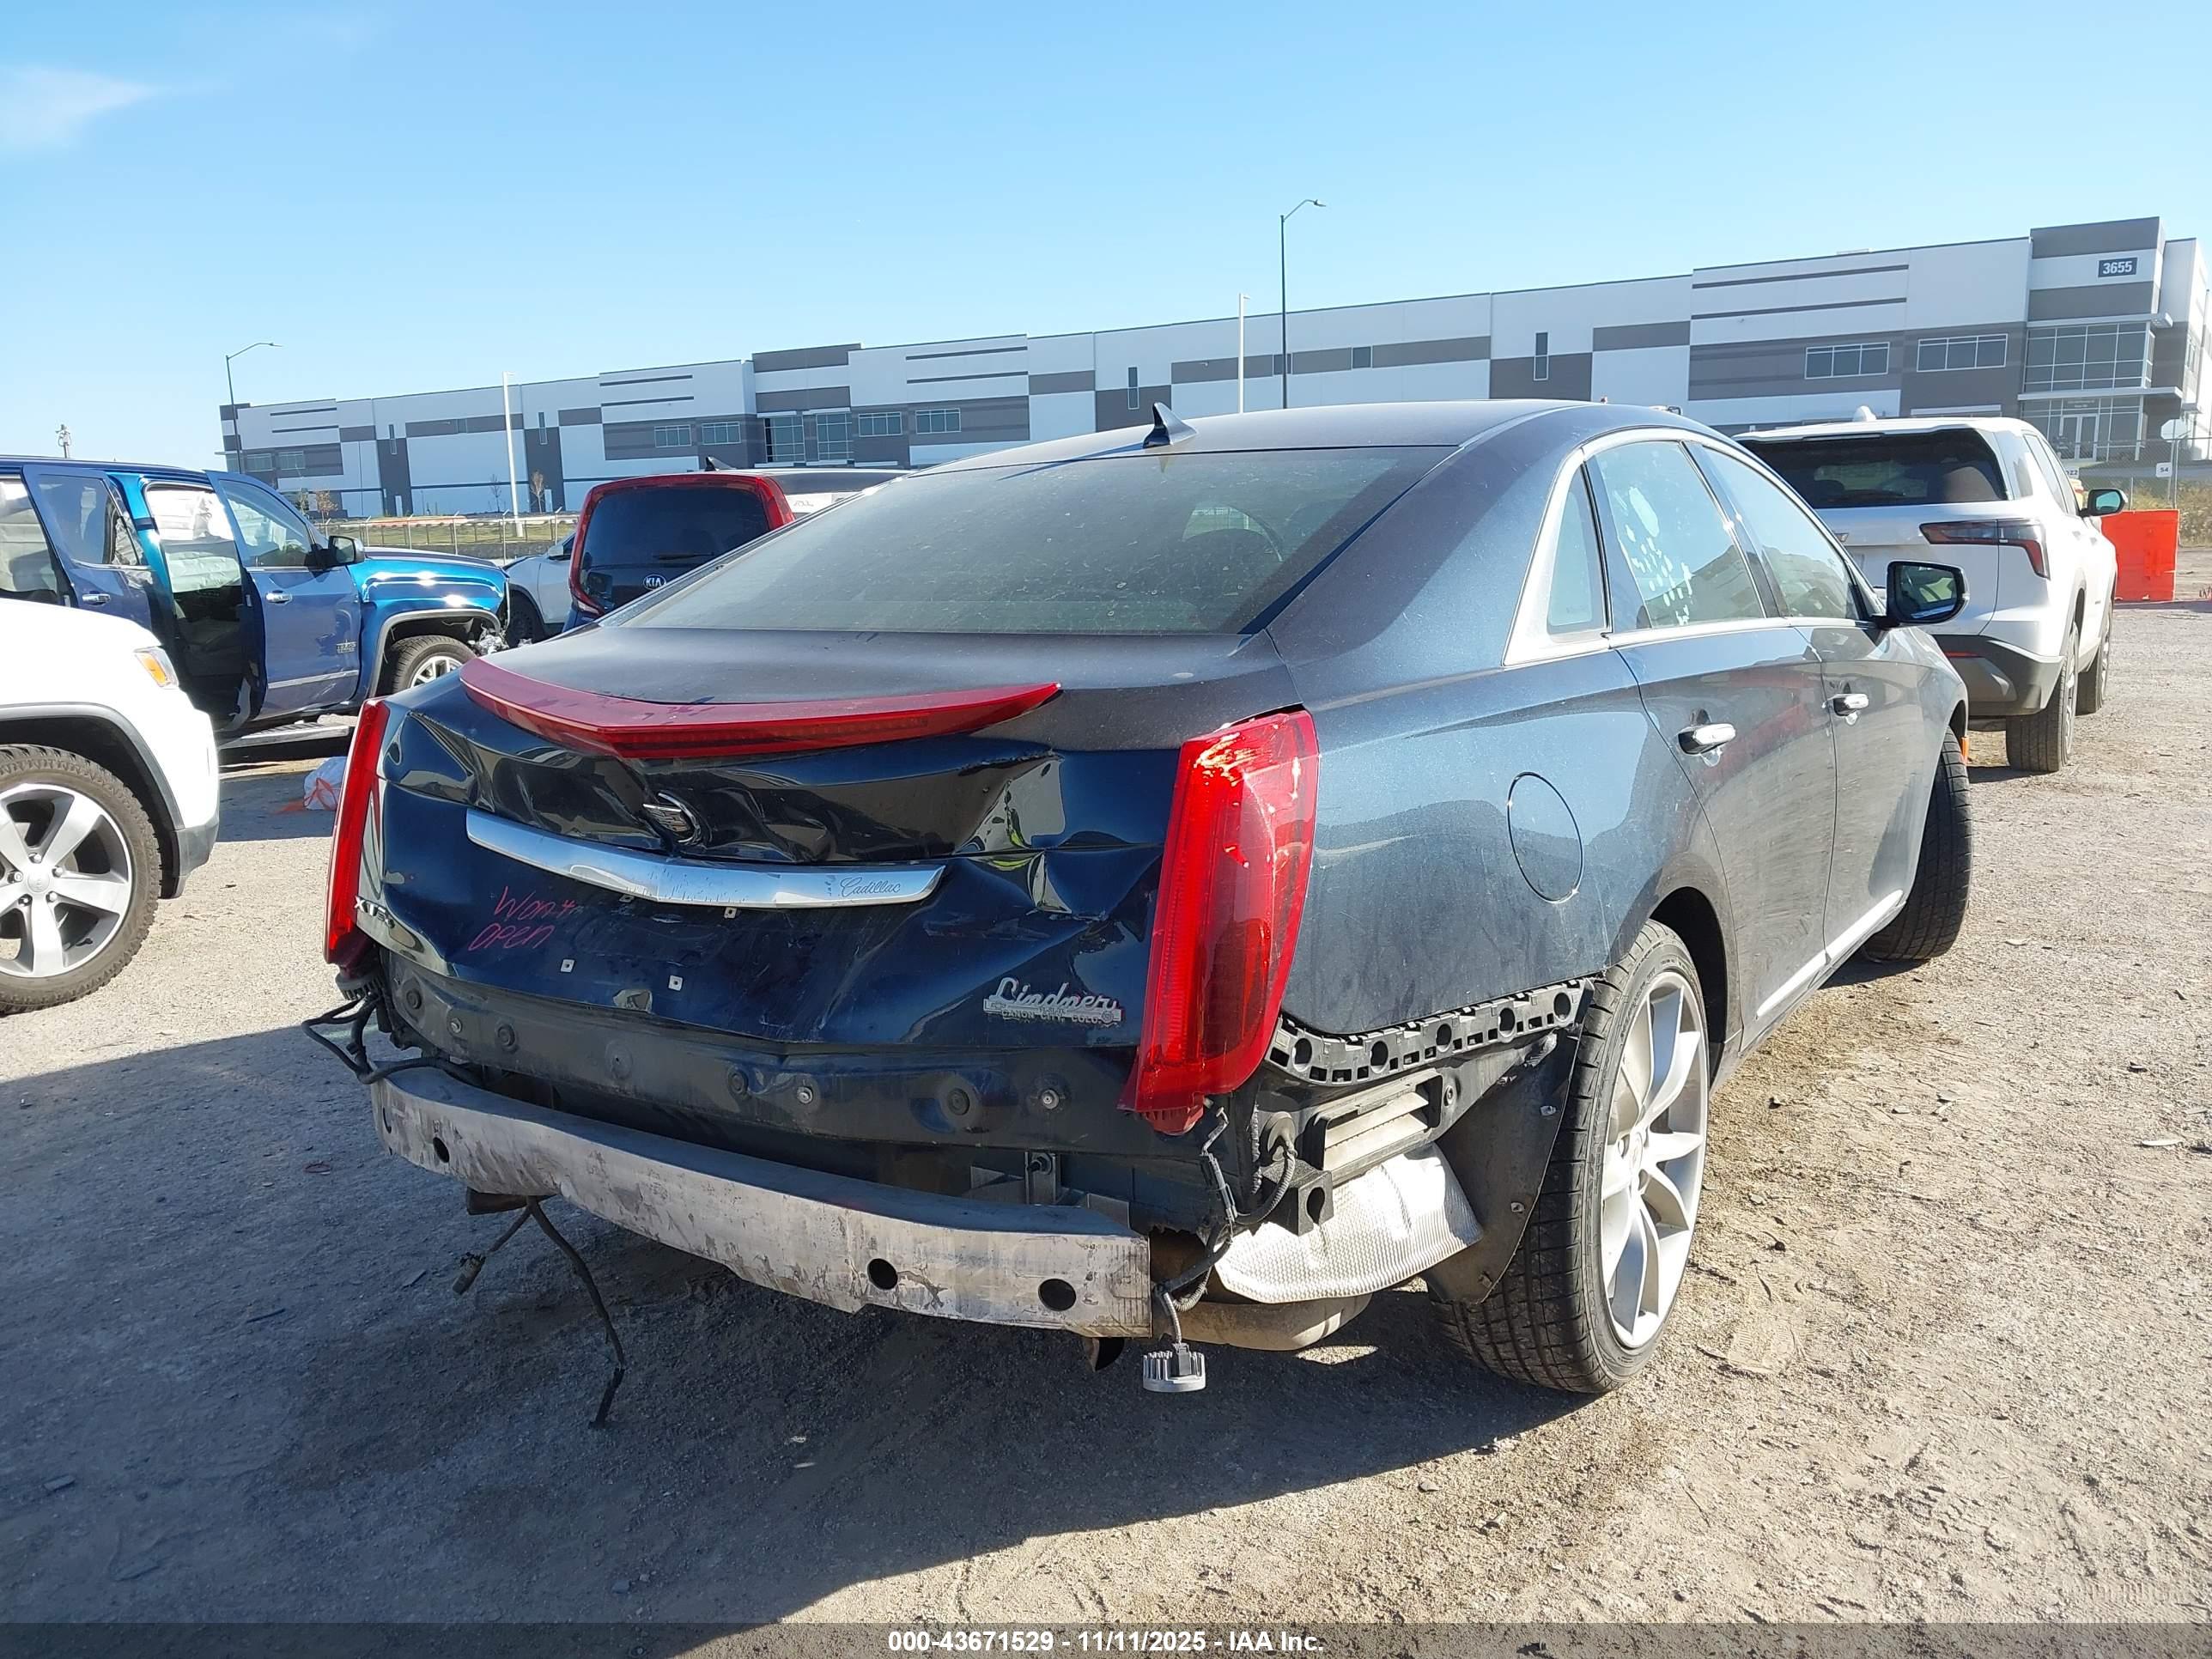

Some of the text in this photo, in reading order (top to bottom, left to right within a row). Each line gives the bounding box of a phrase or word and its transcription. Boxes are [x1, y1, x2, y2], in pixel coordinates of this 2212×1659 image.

[2102, 260, 2133, 275] 3655
[646, 577, 662, 587] KIA
[840, 876, 901, 897] Cadillac
[988, 976, 1117, 1010] Lindner
